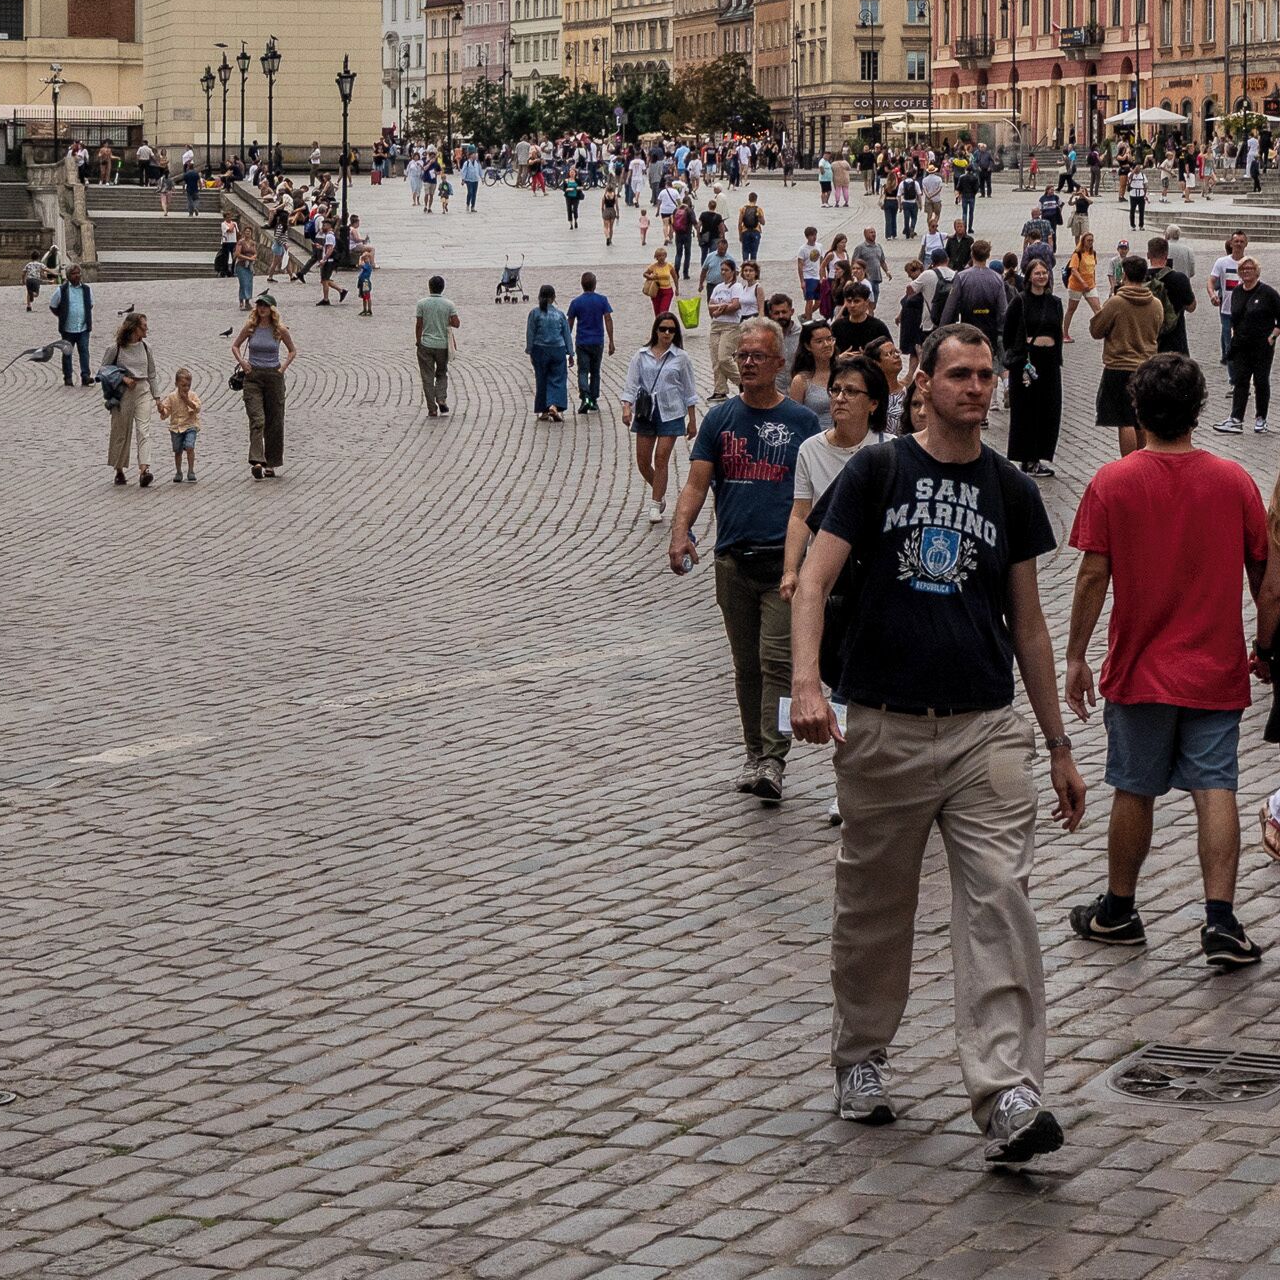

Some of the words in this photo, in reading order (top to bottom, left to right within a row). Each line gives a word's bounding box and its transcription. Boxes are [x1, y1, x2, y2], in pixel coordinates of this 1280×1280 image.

[853, 99, 889, 108] COTA
[721, 431, 748, 455] The
[915, 478, 980, 510] SAN
[883, 502, 997, 547] MARINO
